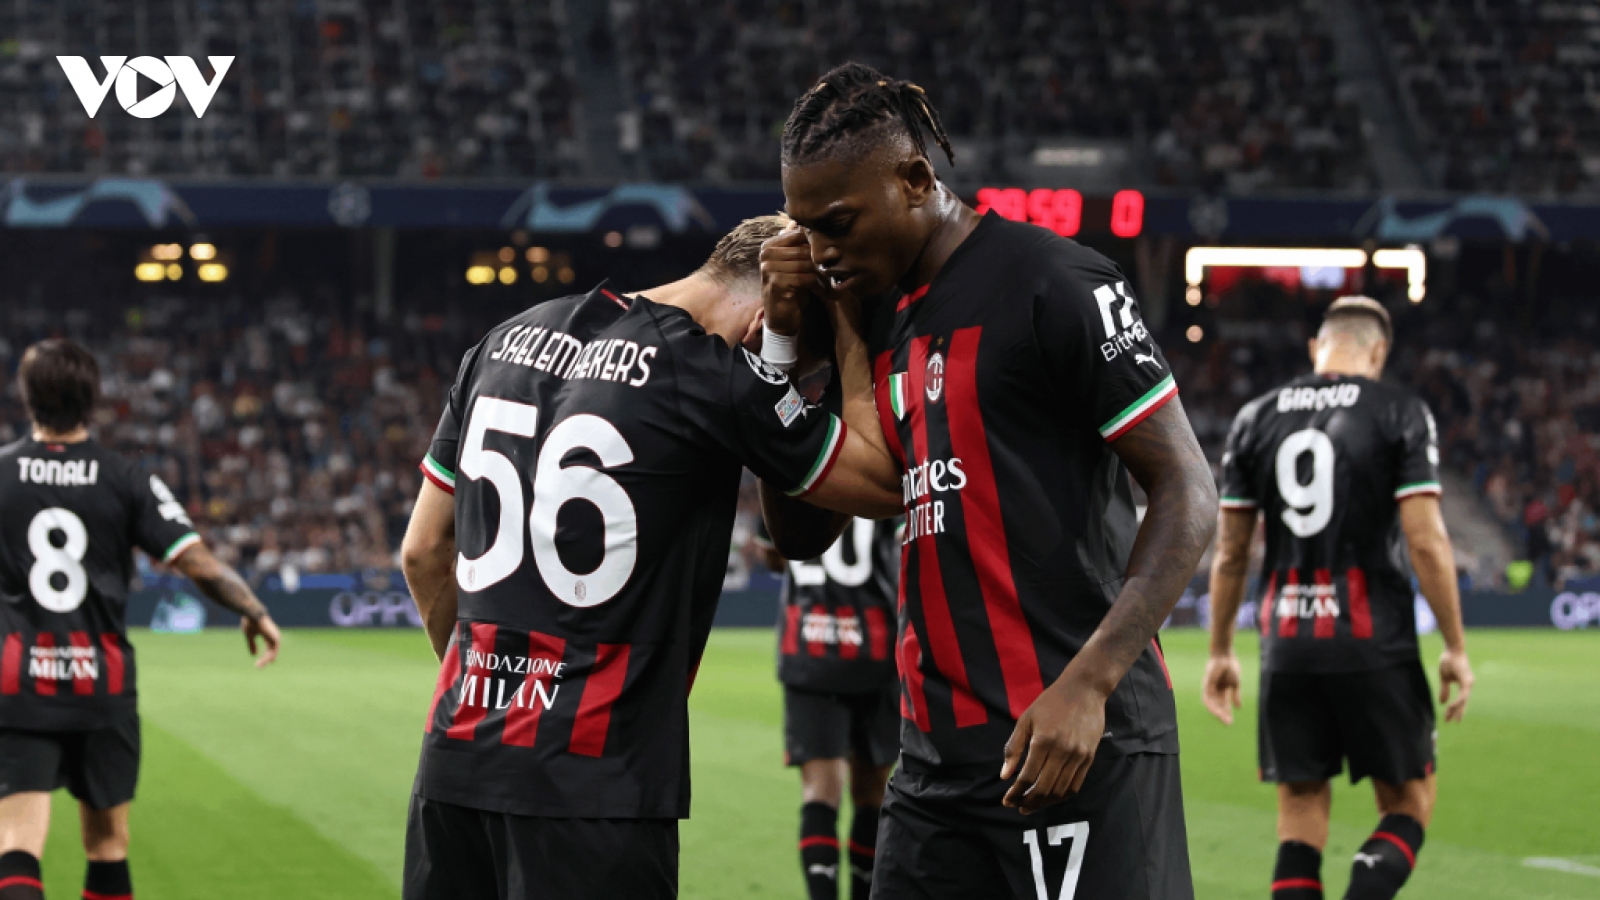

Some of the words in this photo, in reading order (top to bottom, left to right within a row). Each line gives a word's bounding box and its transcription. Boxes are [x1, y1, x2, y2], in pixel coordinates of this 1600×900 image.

[491, 324, 658, 388] SAELEMAEKERS
[1100, 319, 1149, 361] BitME
[1277, 384, 1360, 412] GIROUD
[17, 457, 99, 486] TONALI
[1275, 428, 1335, 538] 9
[456, 395, 638, 608] 56
[28, 507, 88, 612] 8
[789, 516, 875, 586] 0
[28, 658, 99, 680] MILAN
[466, 648, 567, 679] FONDAZIONE
[458, 674, 560, 710] MILAN
[1023, 820, 1089, 900] 17
